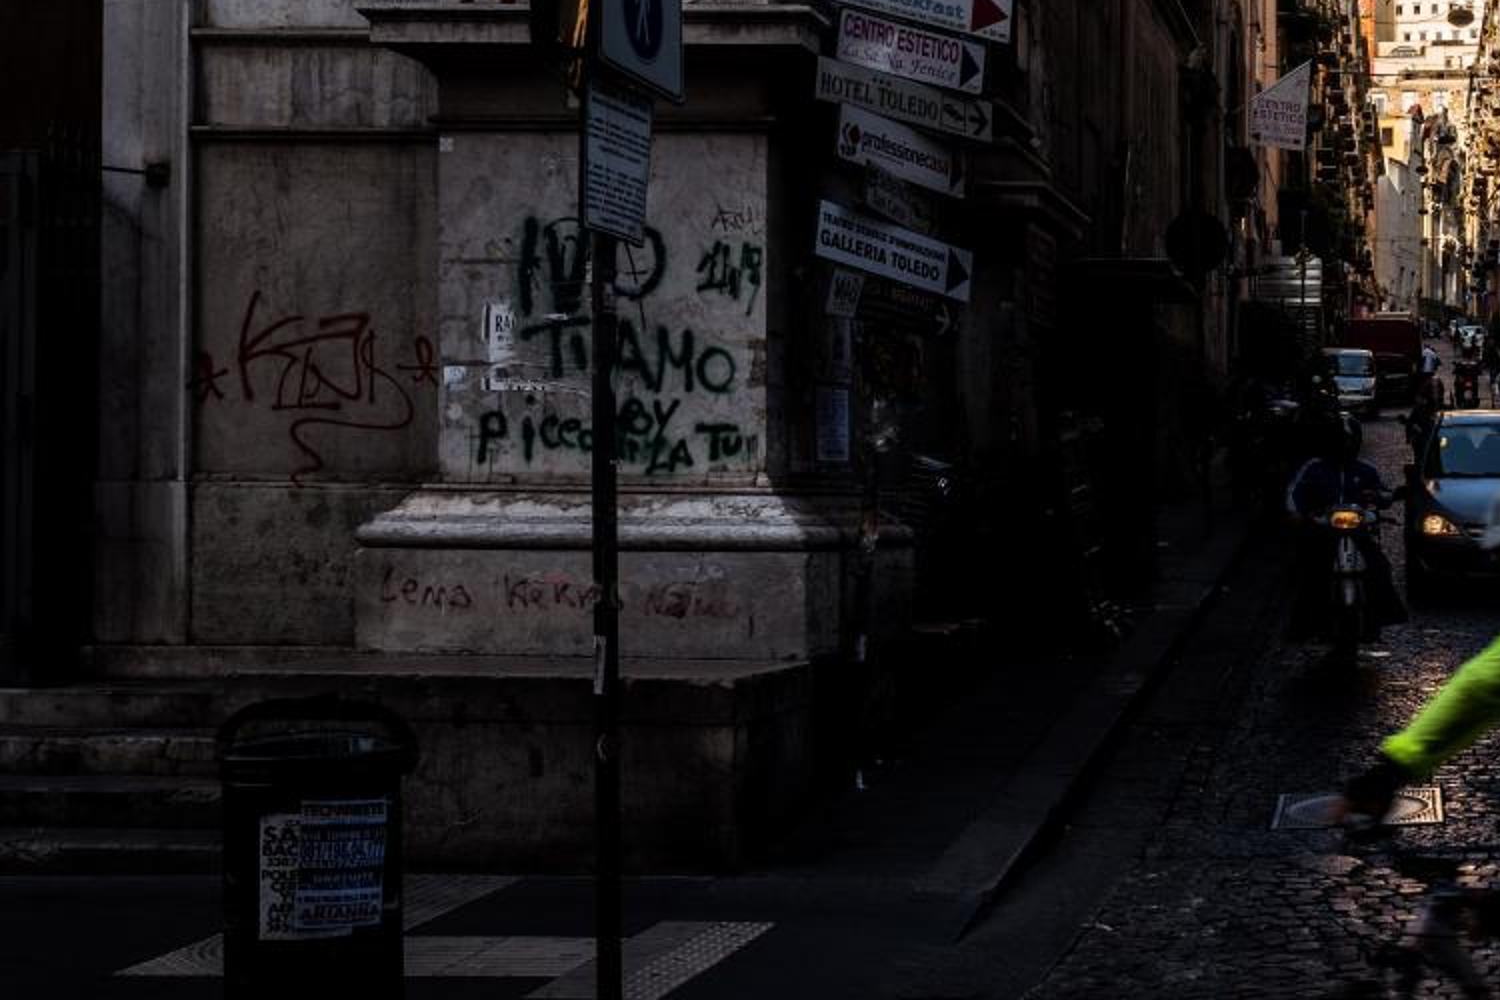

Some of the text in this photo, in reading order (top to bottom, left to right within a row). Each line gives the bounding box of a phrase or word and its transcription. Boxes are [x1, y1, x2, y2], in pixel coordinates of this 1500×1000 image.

[843, 14, 896, 48] CENTRO
[898, 29, 960, 65] ESTETICO
[820, 72, 939, 122] HOTEL TOLEDO
[1253, 109, 1305, 124] ESTETICO
[1257, 99, 1301, 112] CENTRO
[821, 230, 940, 281] GALLERIA TOLEDO
[614, 320, 736, 393] AMO
